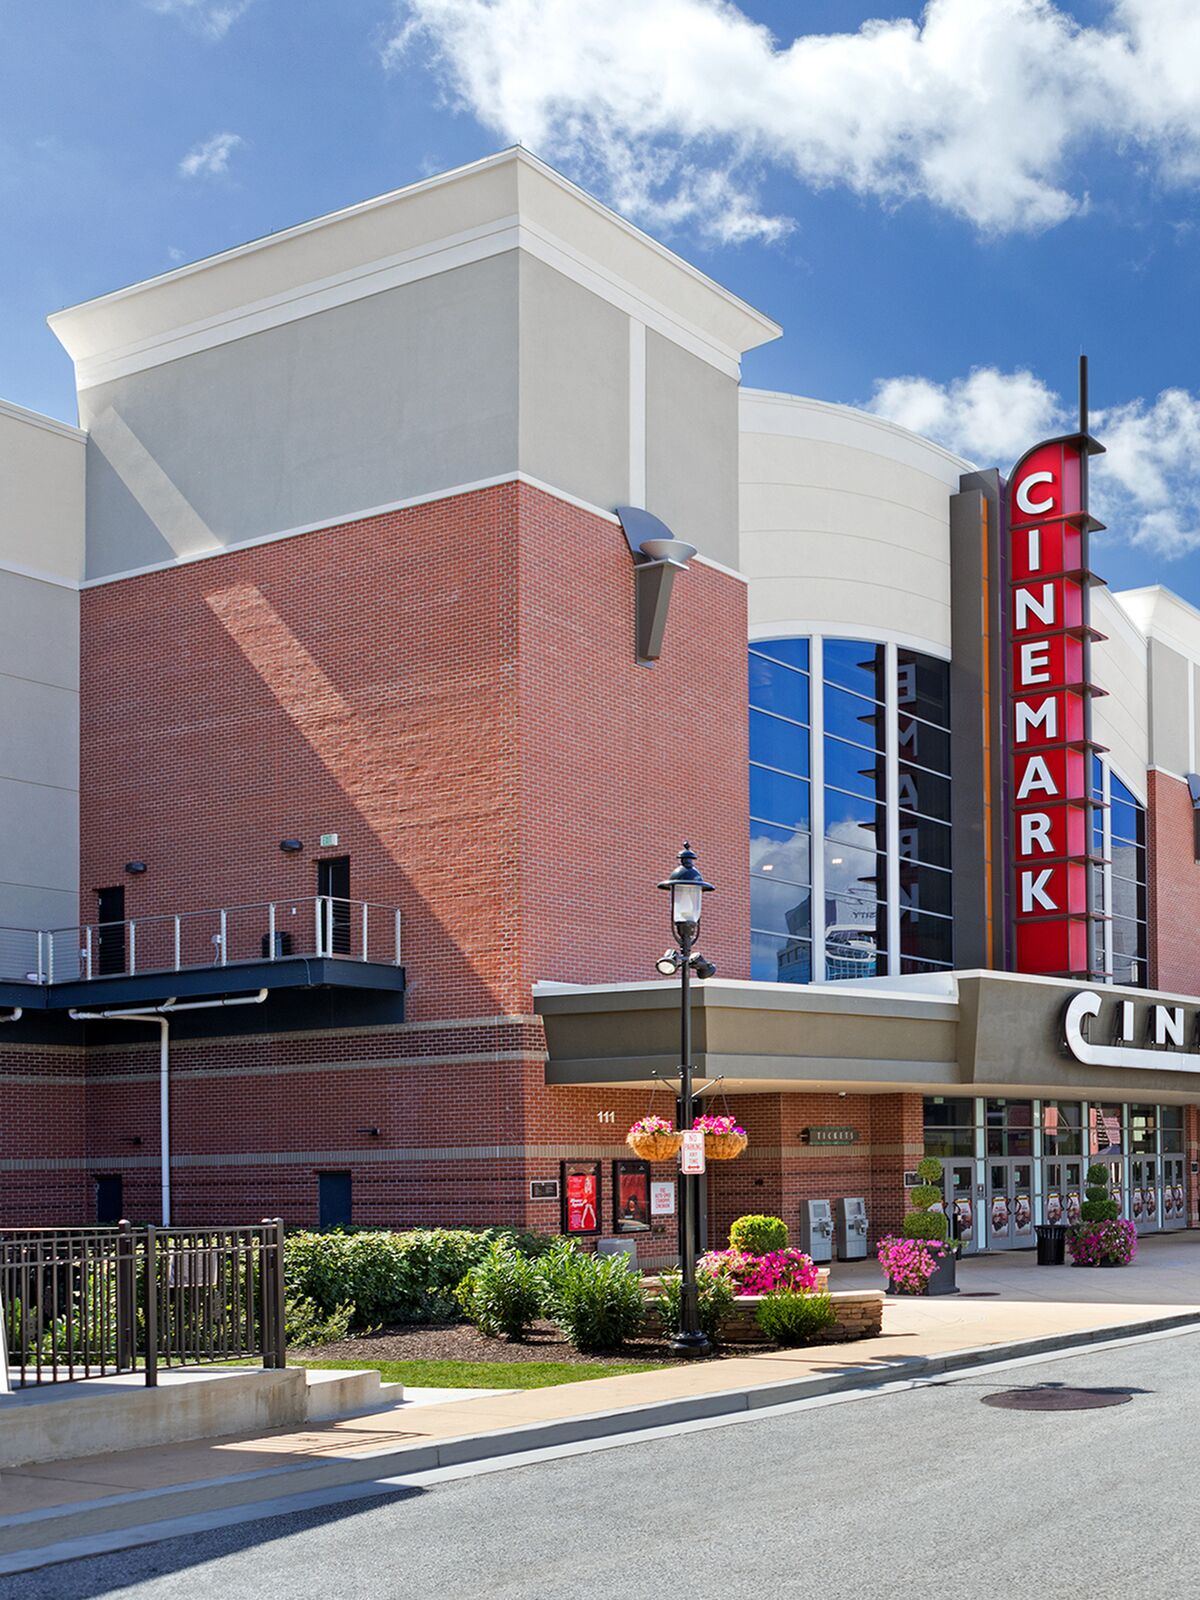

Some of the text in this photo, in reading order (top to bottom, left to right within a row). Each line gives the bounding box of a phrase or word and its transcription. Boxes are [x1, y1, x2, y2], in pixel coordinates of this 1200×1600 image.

[1016, 471, 1058, 913] CINEMARK
[597, 1111, 615, 1123] 111
[689, 1134, 698, 1142] NO
[817, 1131, 854, 1140] TICKETS
